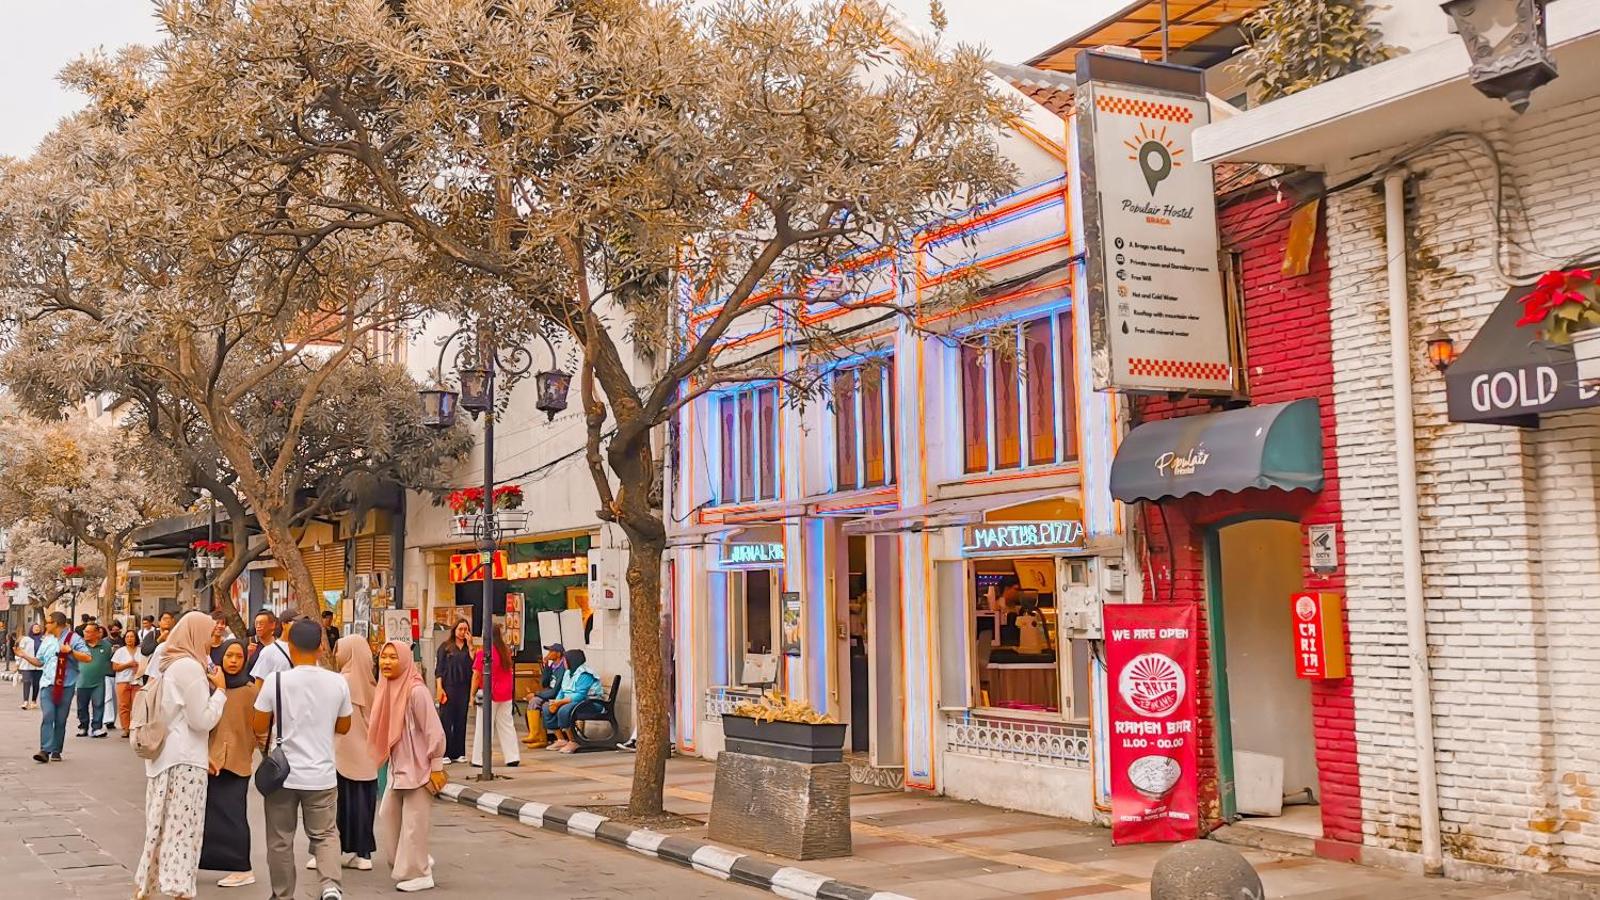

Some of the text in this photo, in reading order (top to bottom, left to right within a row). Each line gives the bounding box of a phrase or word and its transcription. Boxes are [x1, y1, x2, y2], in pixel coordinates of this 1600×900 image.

[1121, 199, 1194, 219] Populair Hostel
[1146, 216, 1171, 226] BRAGA
[1152, 292, 1163, 300] Cold
[1133, 309, 1152, 318] Rooftop
[1471, 366, 1558, 412] GOLD
[1039, 522, 1084, 545] PIZZA
[1112, 628, 1189, 641] WE ARE OPEN
[1134, 681, 1178, 696] CARITA
[1114, 720, 1192, 736] RAMEN BAR
[1122, 738, 1148, 748] 11.00
[1156, 737, 1184, 749] 00.00
